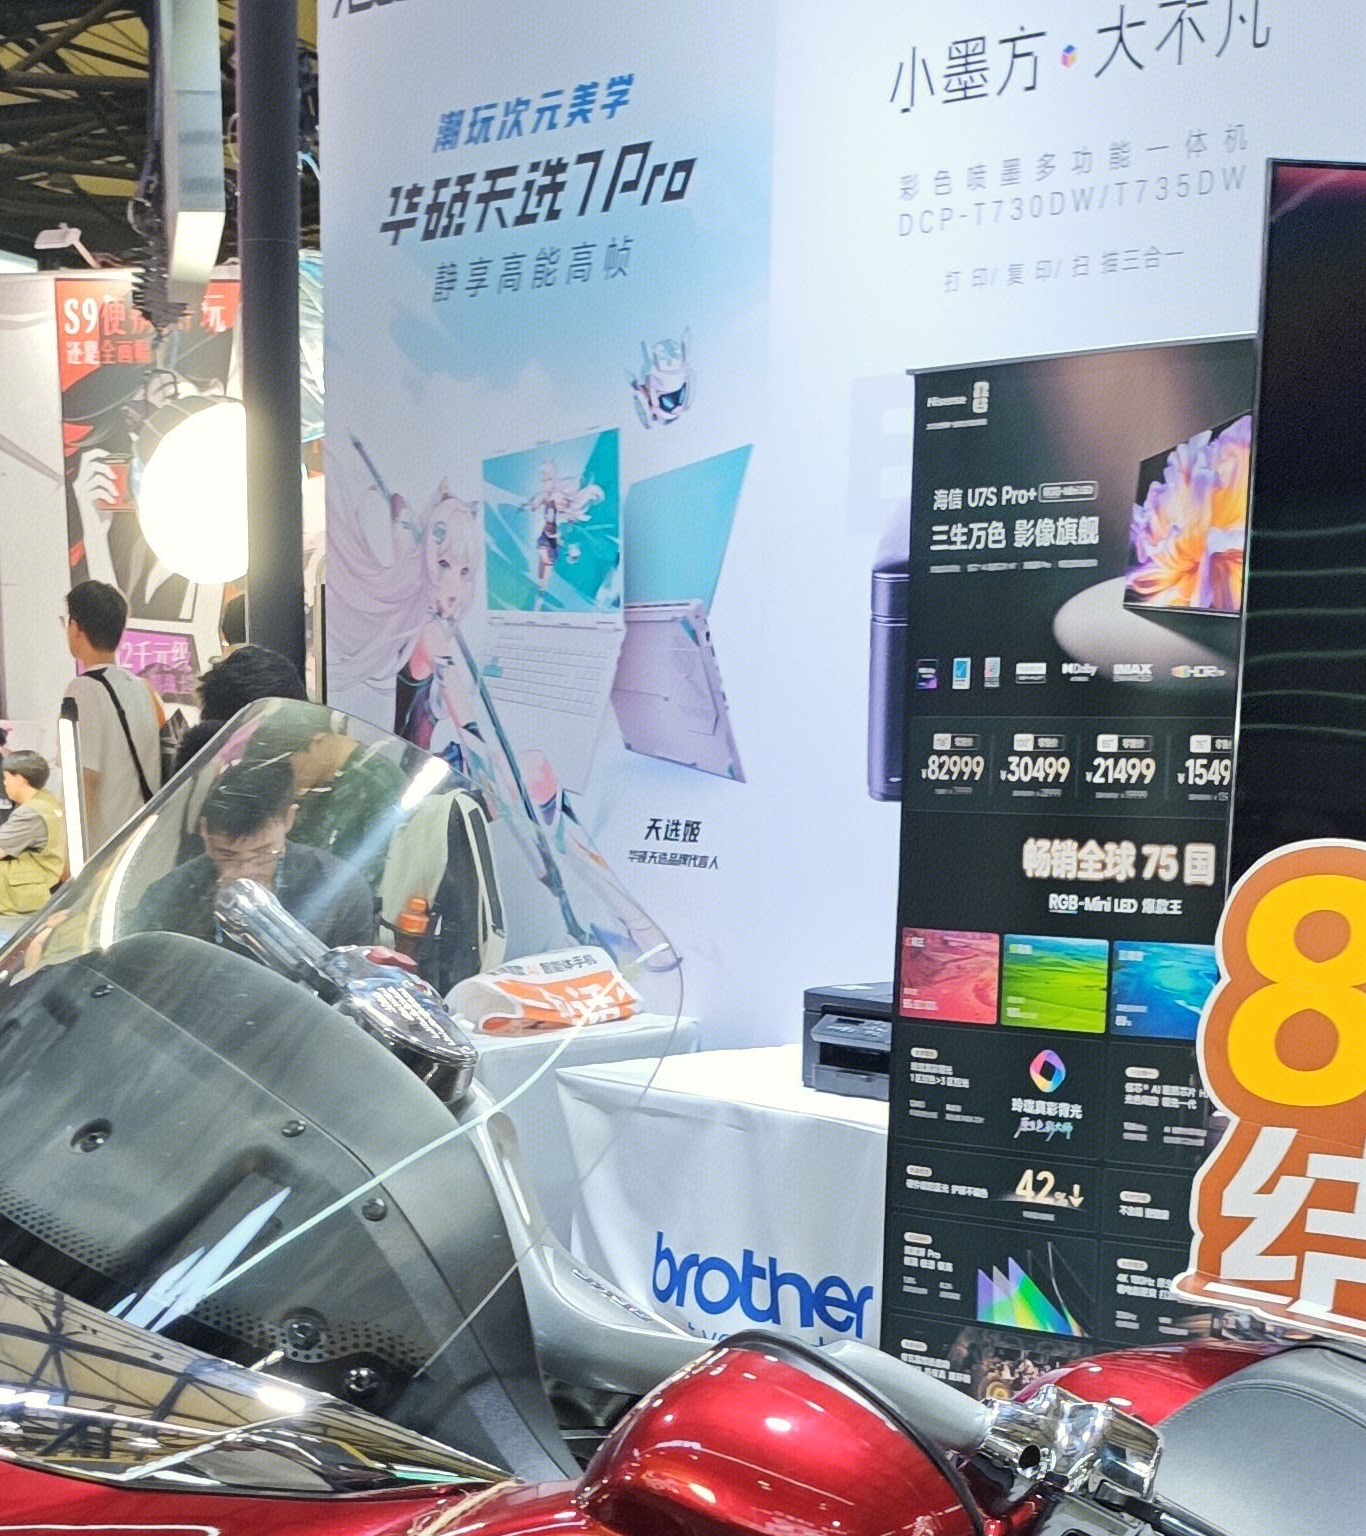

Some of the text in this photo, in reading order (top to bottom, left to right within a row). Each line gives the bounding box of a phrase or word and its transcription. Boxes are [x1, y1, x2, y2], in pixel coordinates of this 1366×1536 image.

[890, 0, 1272, 114] 小墨方 大不凡
[432, 73, 634, 153] 潮玩次元美学
[898, 123, 1248, 202] 彩色喷墨多功能一体机
[898, 164, 1248, 237] DCP-T730DW/T735DW
[967, 486, 997, 508] U7S
[1001, 485, 1037, 506] Pro+
[930, 520, 1006, 550] 三生万色
[1141, 843, 1179, 882] 75
[1113, 898, 1139, 914] LED
[651, 1230, 874, 1340] brother
